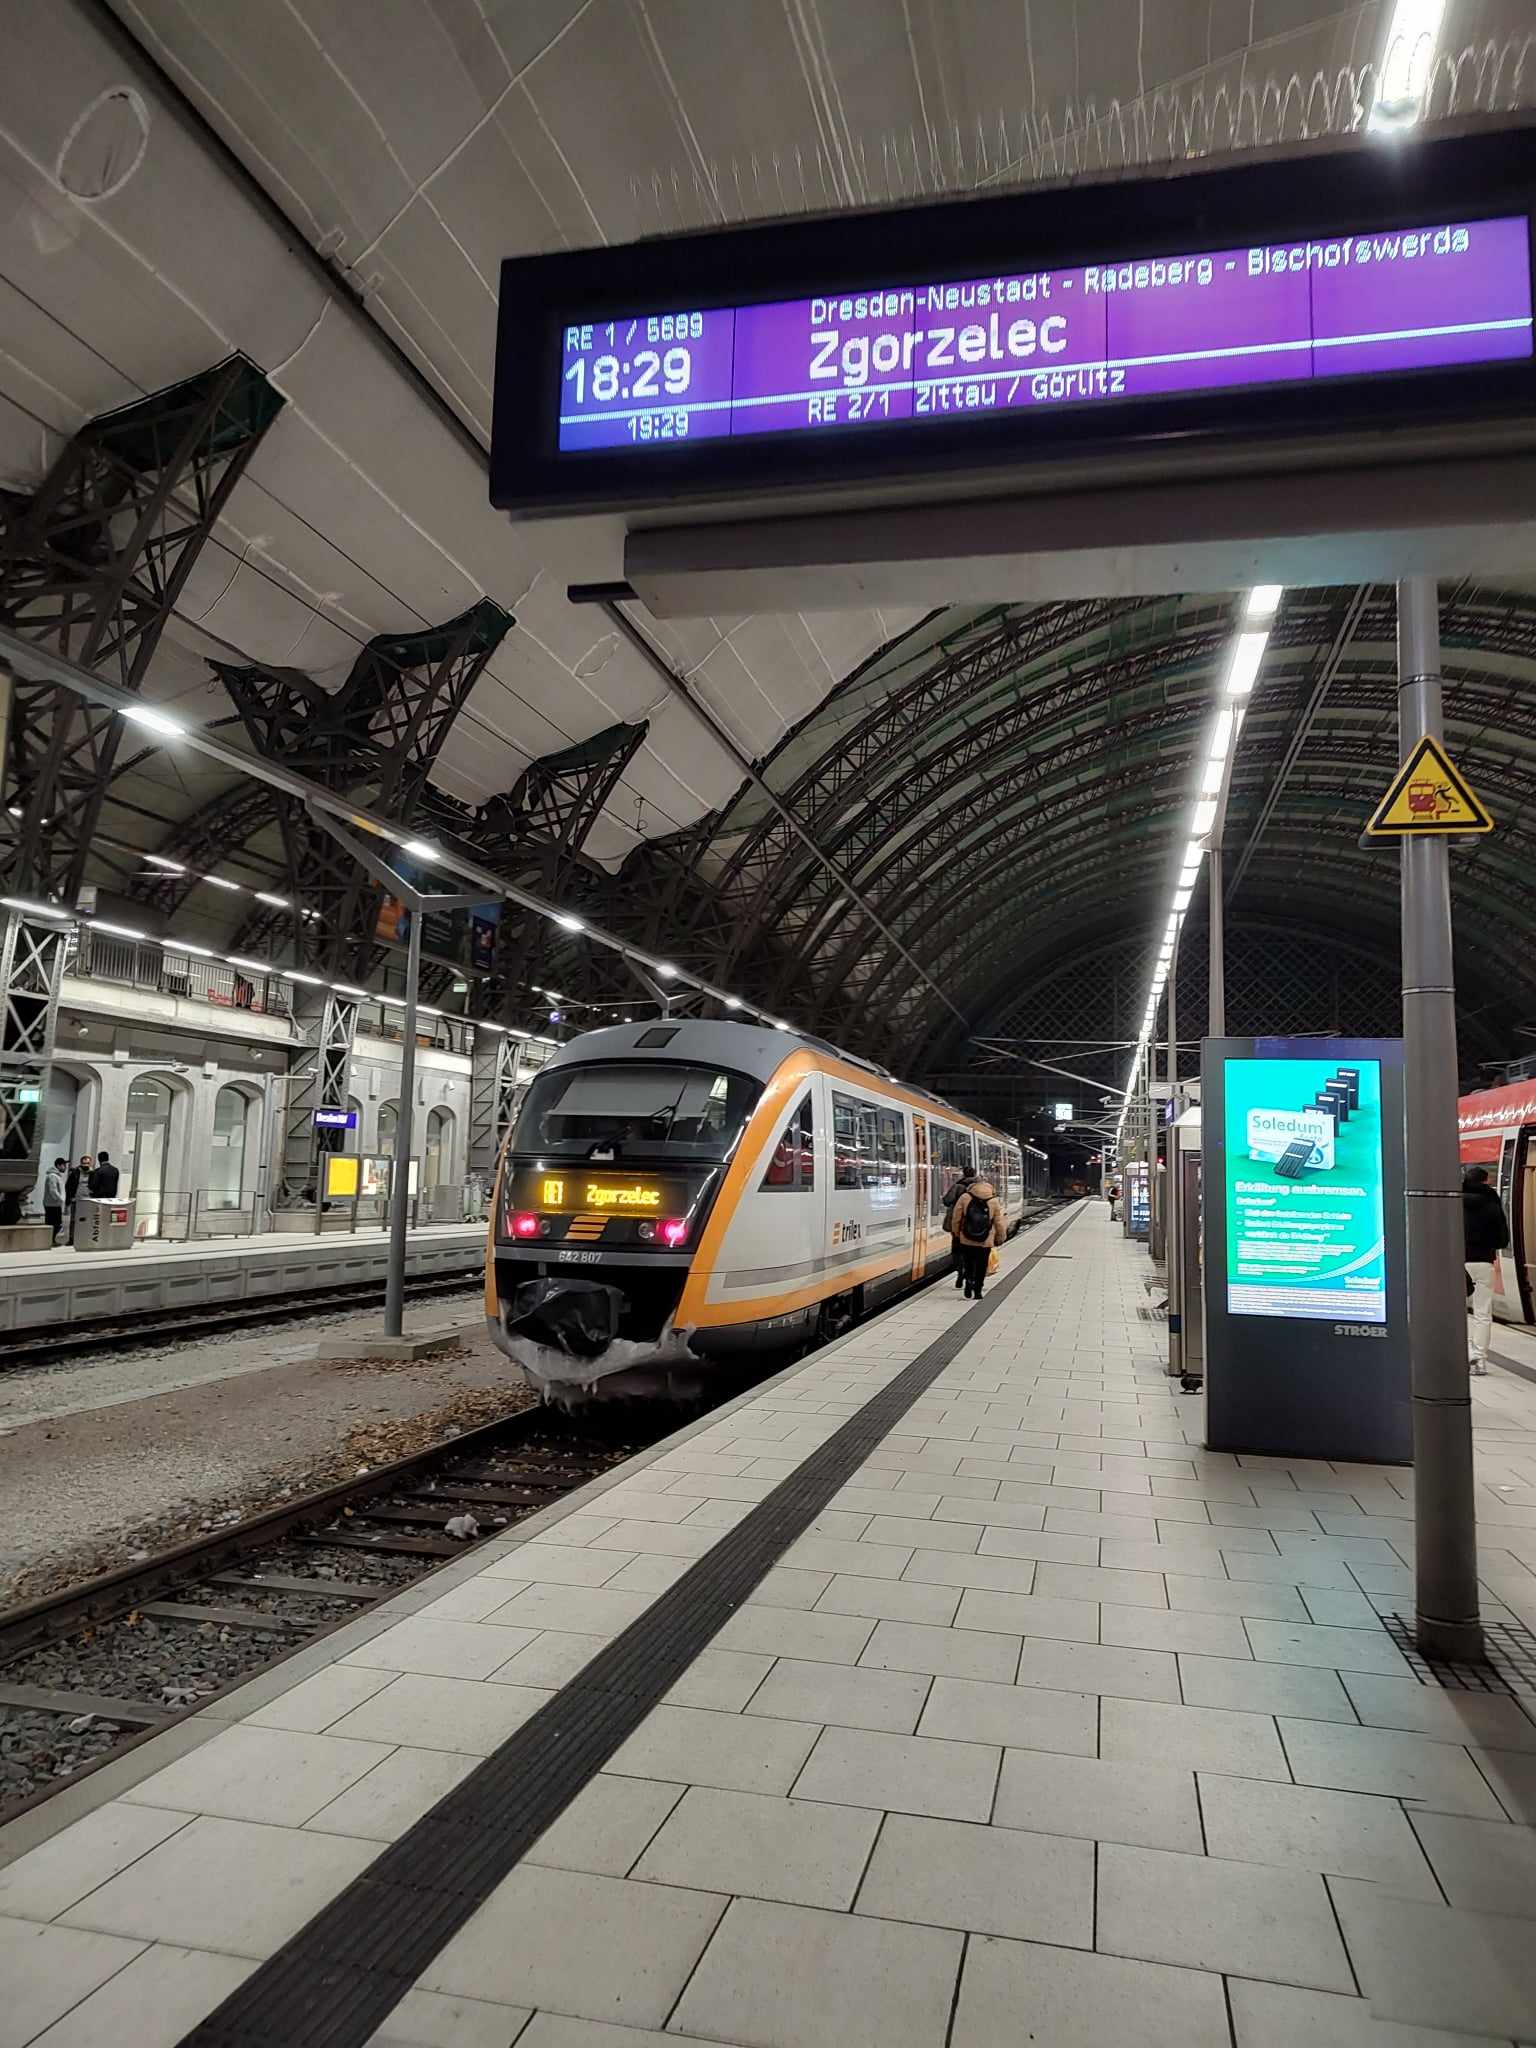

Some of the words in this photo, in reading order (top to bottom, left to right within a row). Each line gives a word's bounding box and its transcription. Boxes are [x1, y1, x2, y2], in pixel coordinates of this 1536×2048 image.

[810, 272, 1051, 325] Dresden-Neustadt
[1084, 256, 1214, 294] Radeberg
[1247, 225, 1470, 277] Bischofswerda
[566, 325, 594, 352] RE
[605, 321, 615, 347] 1
[625, 318, 638, 345] /
[809, 312, 1068, 386] Zgorzelec
[564, 346, 692, 404] 18:29
[808, 396, 837, 424] RE
[848, 391, 890, 421] 2/1
[916, 381, 997, 413] Zittau
[1007, 376, 1021, 403] /
[1031, 366, 1126, 401] Görlitz
[627, 410, 690, 441] 19:29
[1251, 1114, 1323, 1135] Soledum
[586, 1184, 660, 1206] Zgorzelec
[1333, 1324, 1388, 1338] STRÖER
